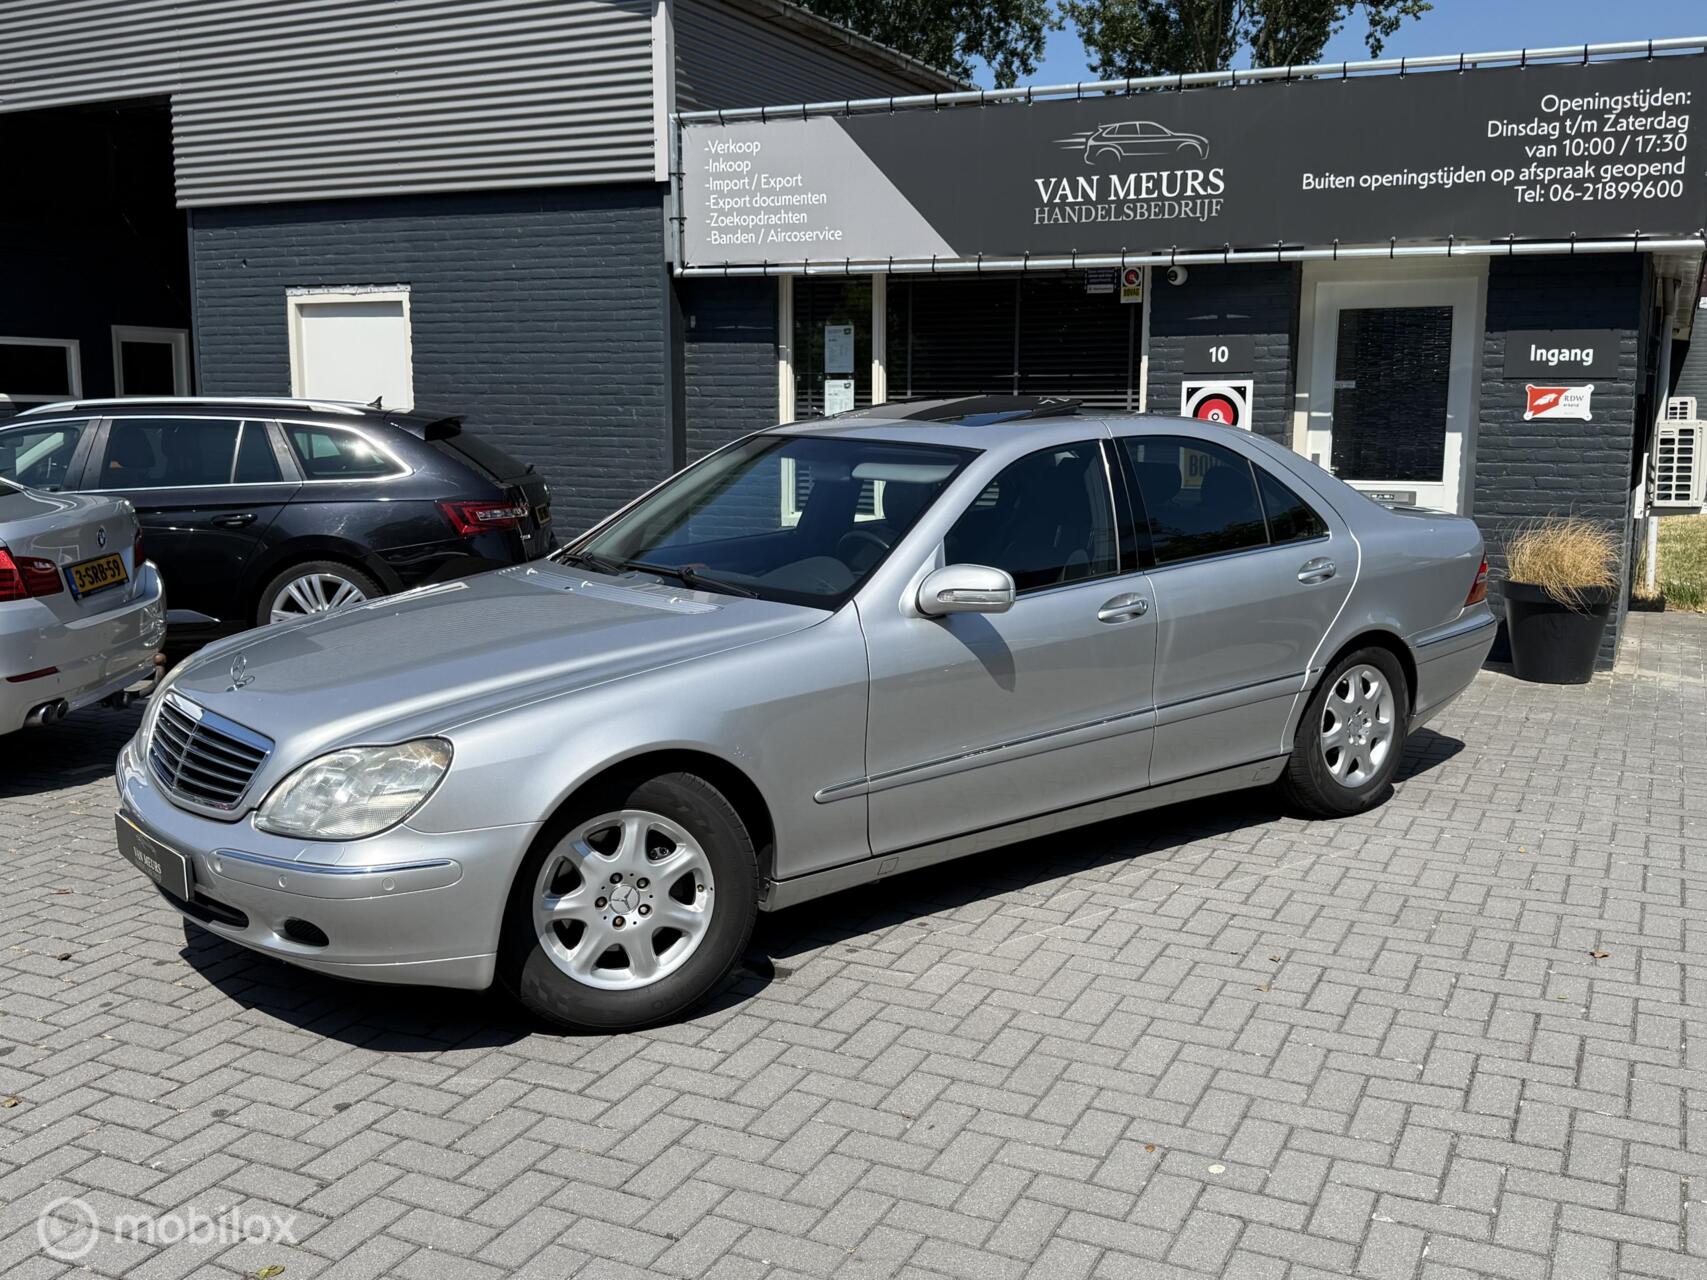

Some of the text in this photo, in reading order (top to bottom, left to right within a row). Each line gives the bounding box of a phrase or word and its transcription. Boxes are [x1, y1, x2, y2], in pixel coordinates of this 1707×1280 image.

[1540, 87, 1692, 116] Openingstijden:
[1487, 110, 1690, 139] Dinsdag t/m Zaterdag
[704, 138, 761, 156] -Verkoop
[1525, 133, 1688, 158] van 10:00 / 17:30
[704, 157, 751, 174] -Inkoop
[1302, 156, 1686, 191] Buiten openingstijden op afspraak geopend
[704, 173, 803, 193] -Import / Export
[1034, 168, 1225, 203] VAN MEURS
[1514, 179, 1684, 203] Tel: 06-21899600
[705, 191, 827, 211] -Export documenten
[1033, 198, 1224, 225] HANDELSBEDRIJF
[706, 226, 843, 245] -Banden / Aircoservice
[1209, 345, 1229, 363] 10
[1530, 344, 1594, 366] Ingang
[75, 559, 120, 588] 3-SRB-59
